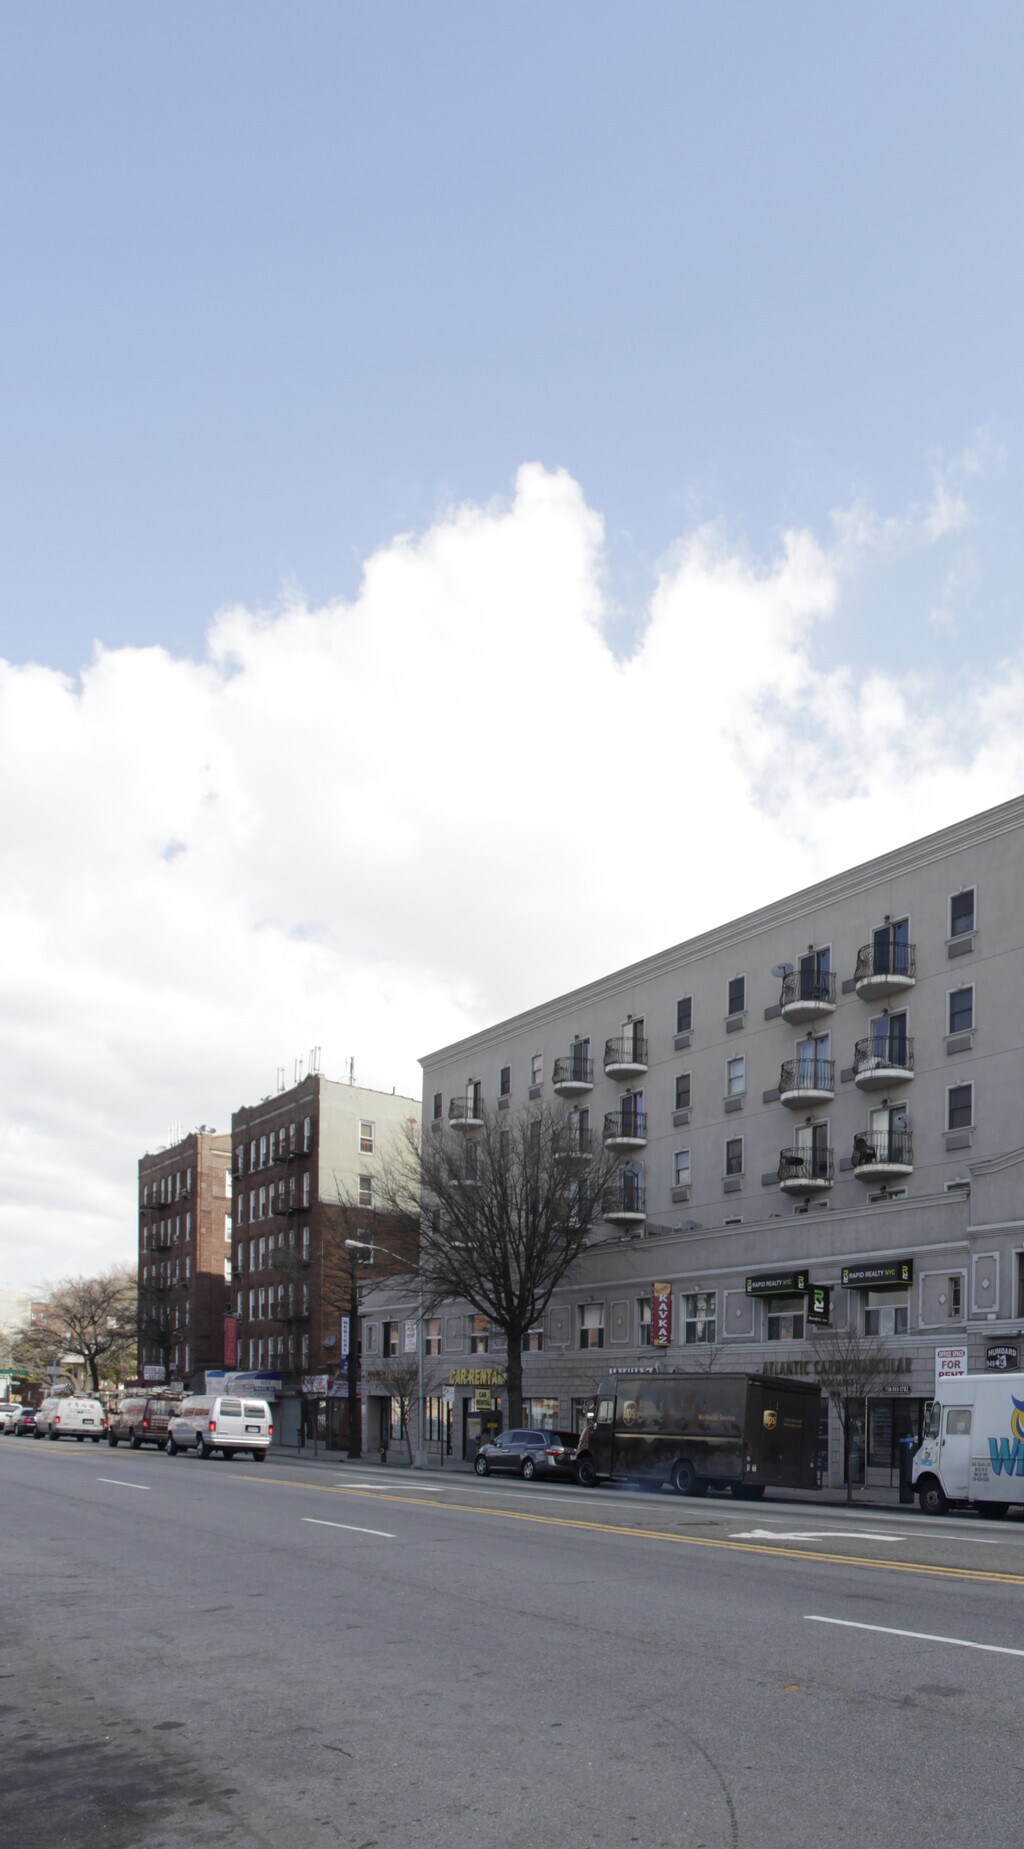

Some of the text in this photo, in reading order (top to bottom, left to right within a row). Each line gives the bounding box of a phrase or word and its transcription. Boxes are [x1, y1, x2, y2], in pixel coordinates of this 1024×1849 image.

[865, 1269, 884, 1278] REALTY
[753, 1280, 766, 1289] RAPID
[766, 1279, 782, 1288] REALTY
[658, 1294, 669, 1344] KAVKAZ
[988, 1348, 1017, 1357] HUMDARD
[763, 1361, 811, 1376] ATLANTIC
[942, 1360, 961, 1369] FOR
[449, 1368, 505, 1385] CAR RENTAL
